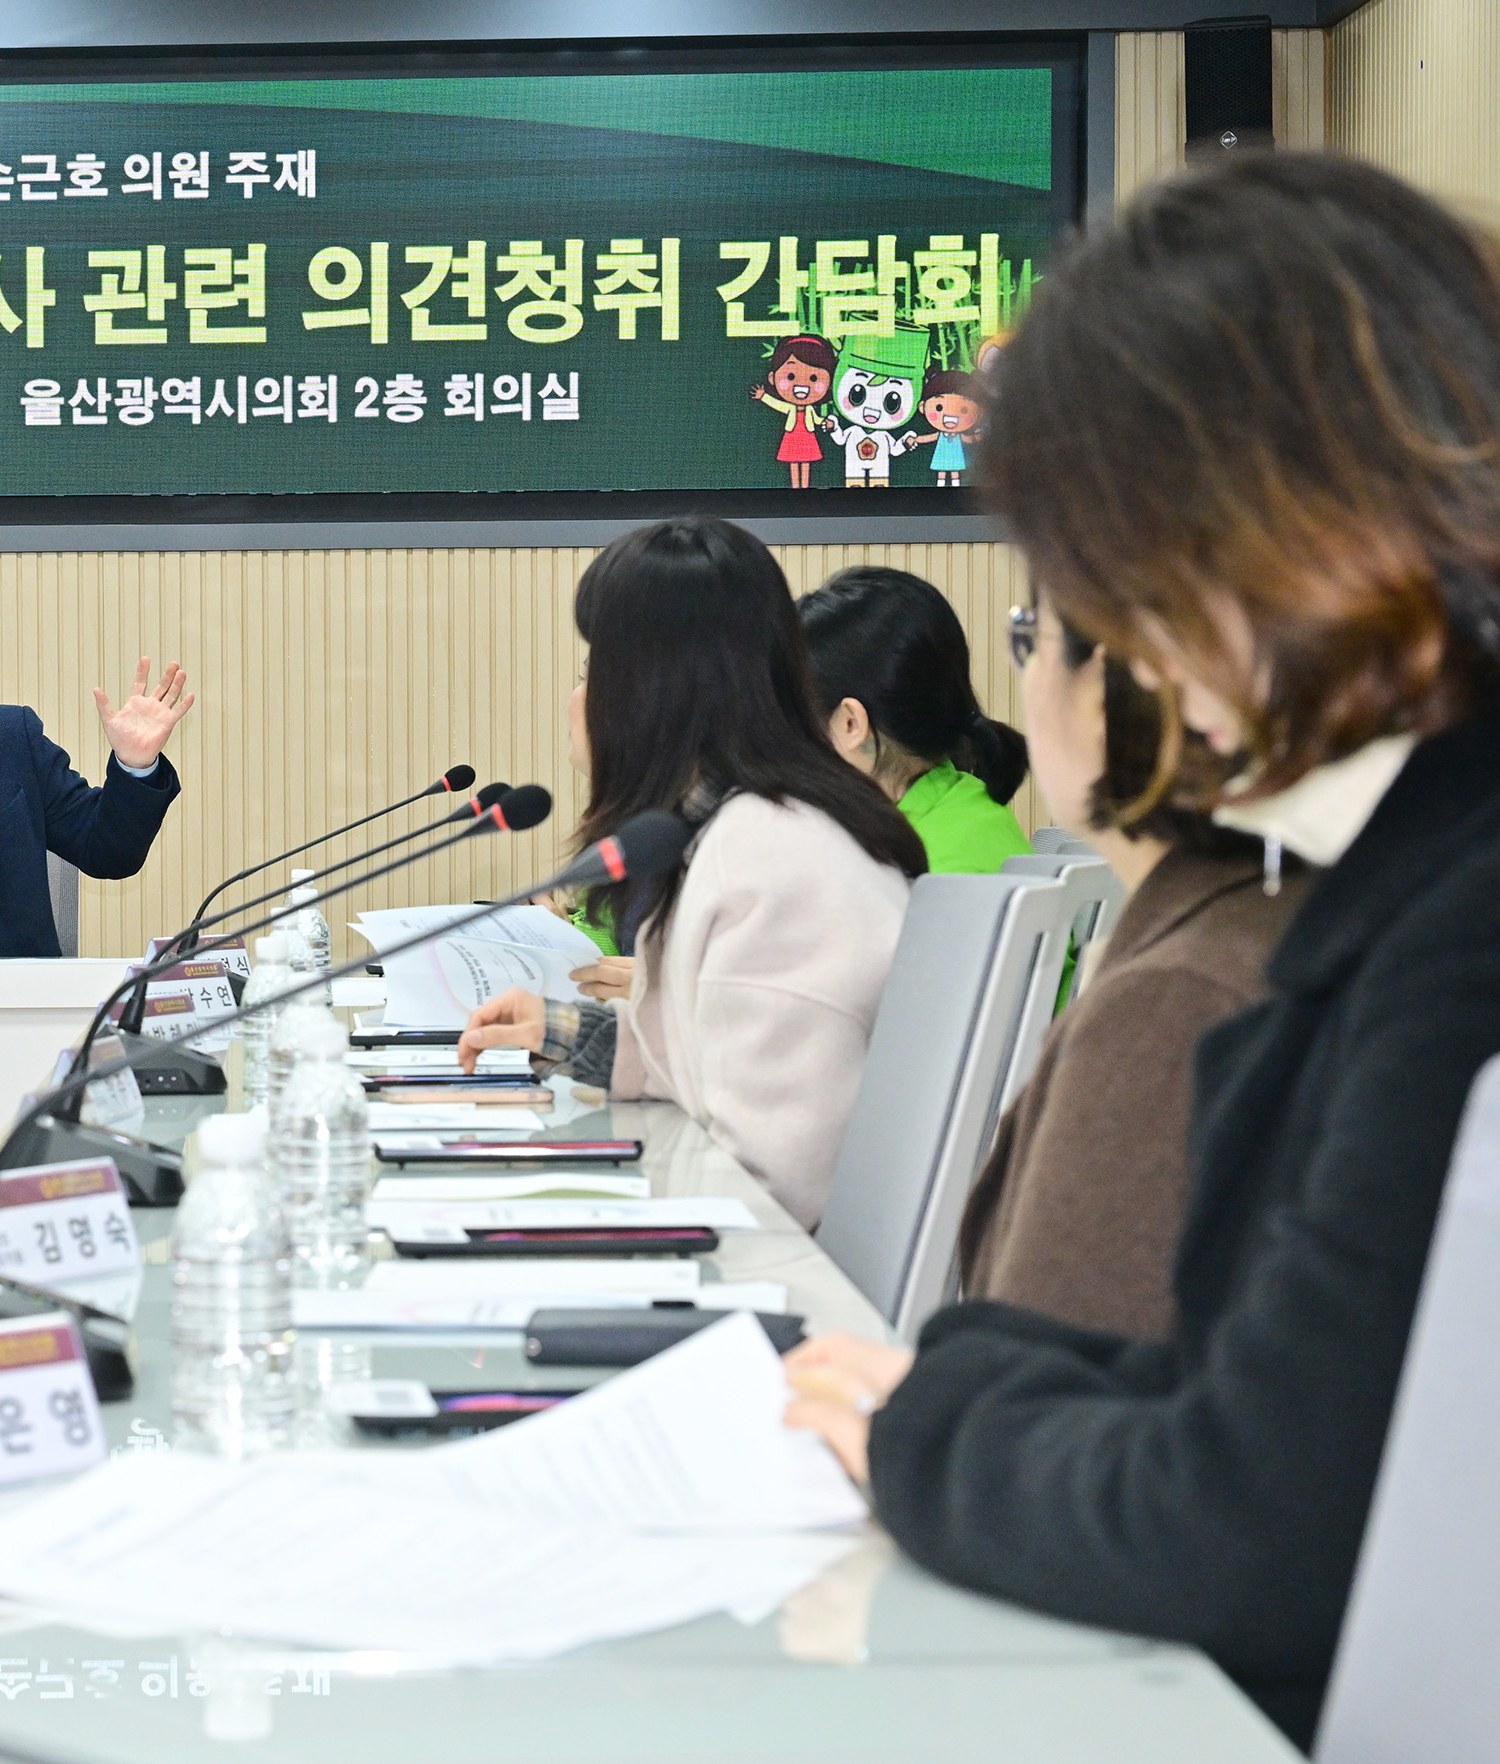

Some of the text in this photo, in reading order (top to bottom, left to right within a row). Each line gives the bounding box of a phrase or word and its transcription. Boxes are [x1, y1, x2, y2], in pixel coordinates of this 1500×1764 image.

[121, 150, 210, 202] 의원
[225, 148, 317, 199] 주재
[81, 242, 267, 346] 관련
[300, 236, 681, 346] 의견청취
[716, 233, 999, 338] 간담회
[20, 370, 581, 427] 울산광역시의회 2층 회의실
